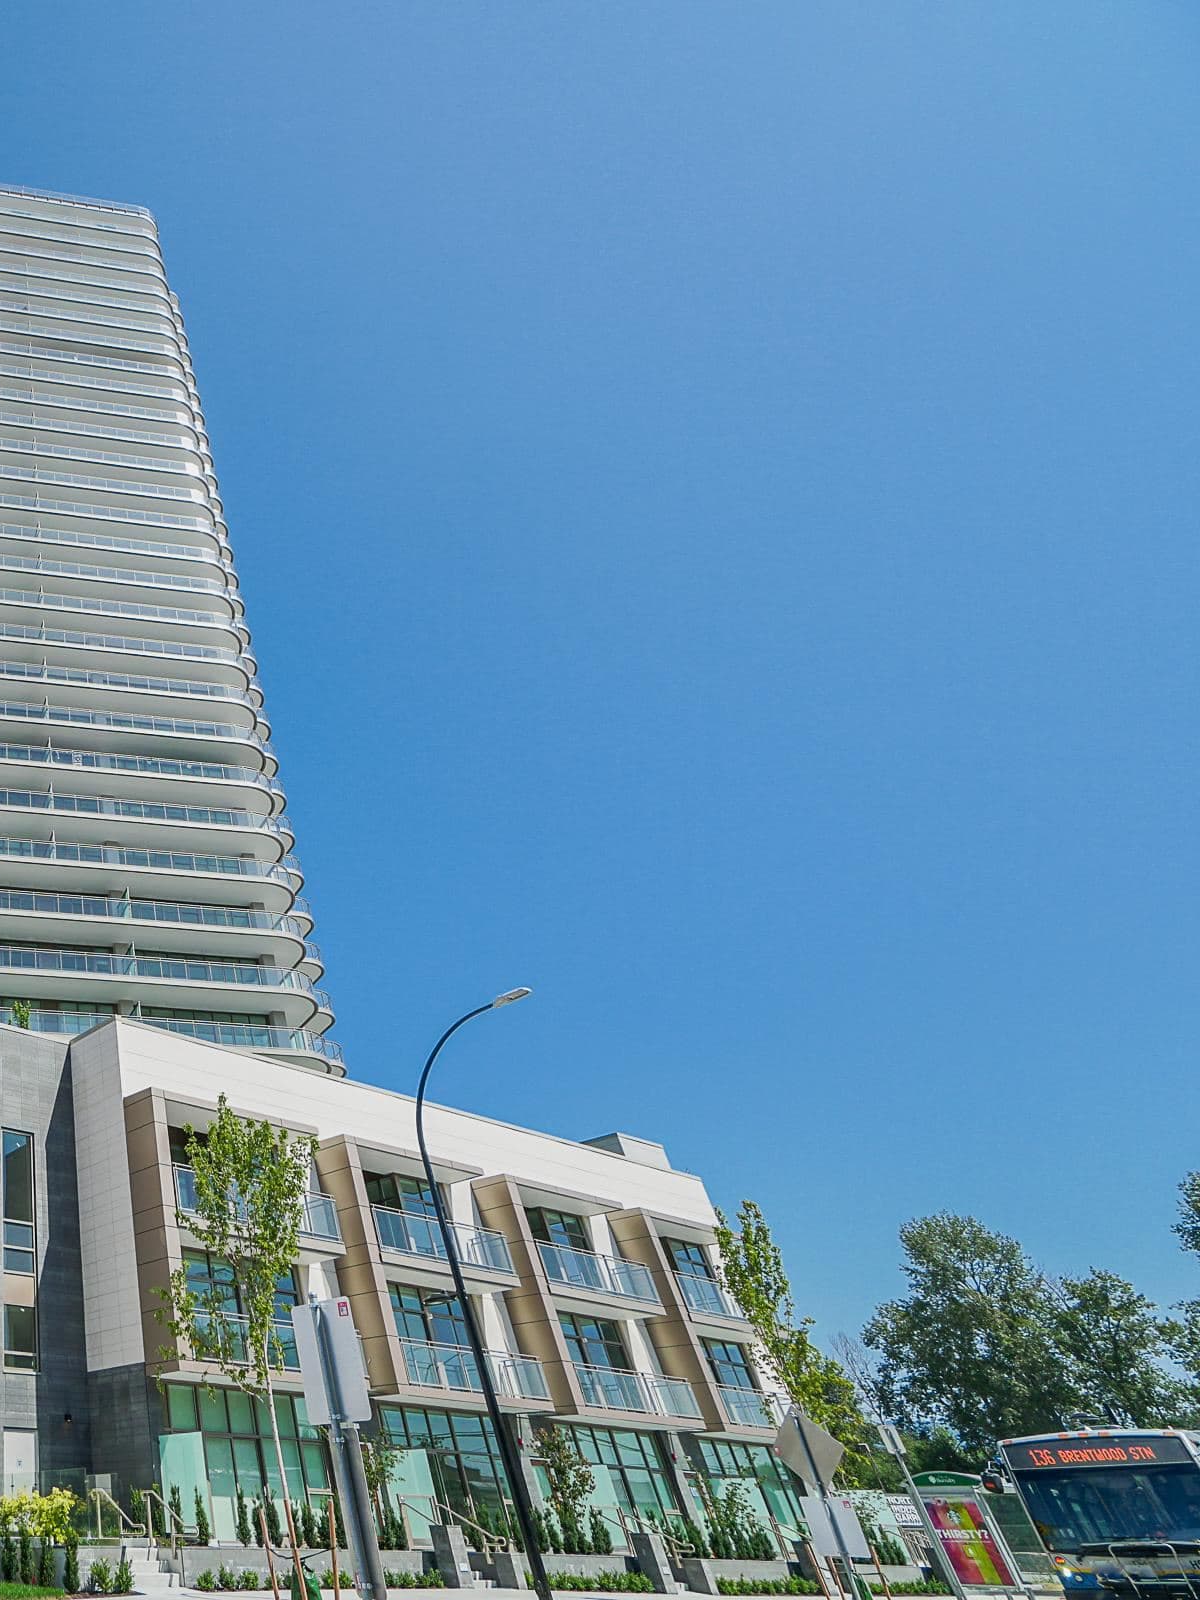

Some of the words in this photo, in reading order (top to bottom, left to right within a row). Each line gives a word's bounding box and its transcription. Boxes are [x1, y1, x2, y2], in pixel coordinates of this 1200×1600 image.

[1028, 1450, 1056, 1466] 136
[1058, 1447, 1128, 1463] BRENTWOOD
[1128, 1446, 1157, 1460] STN
[935, 1529, 990, 1540] THIRSTY?
